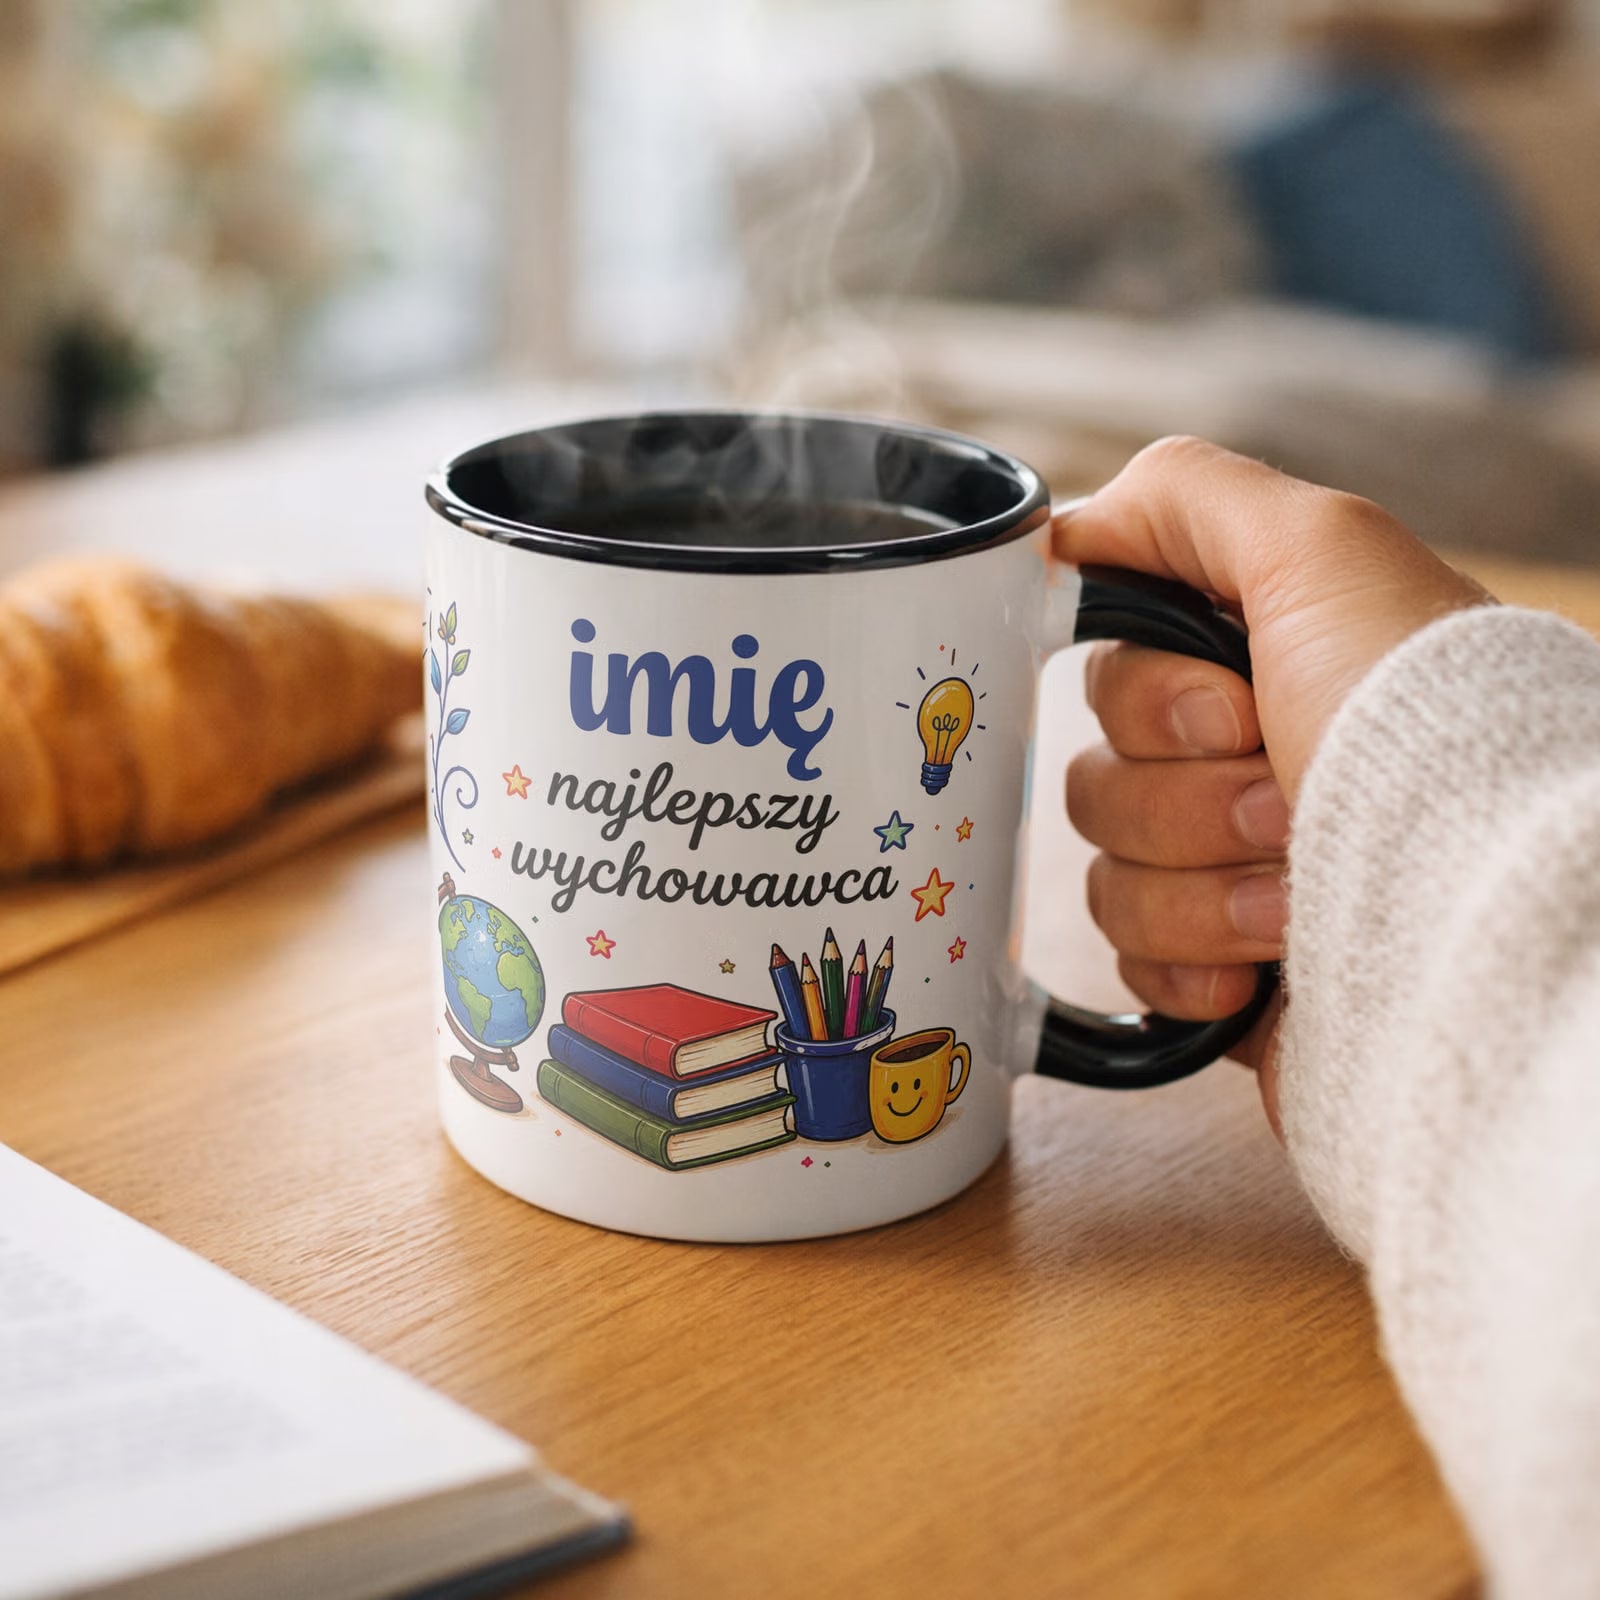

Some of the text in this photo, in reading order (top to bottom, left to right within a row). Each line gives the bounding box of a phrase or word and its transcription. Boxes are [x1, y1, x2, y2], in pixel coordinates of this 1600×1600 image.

[569, 618, 834, 781] imię
[547, 762, 839, 853] najlepszy
[510, 840, 899, 912] wychowawca
